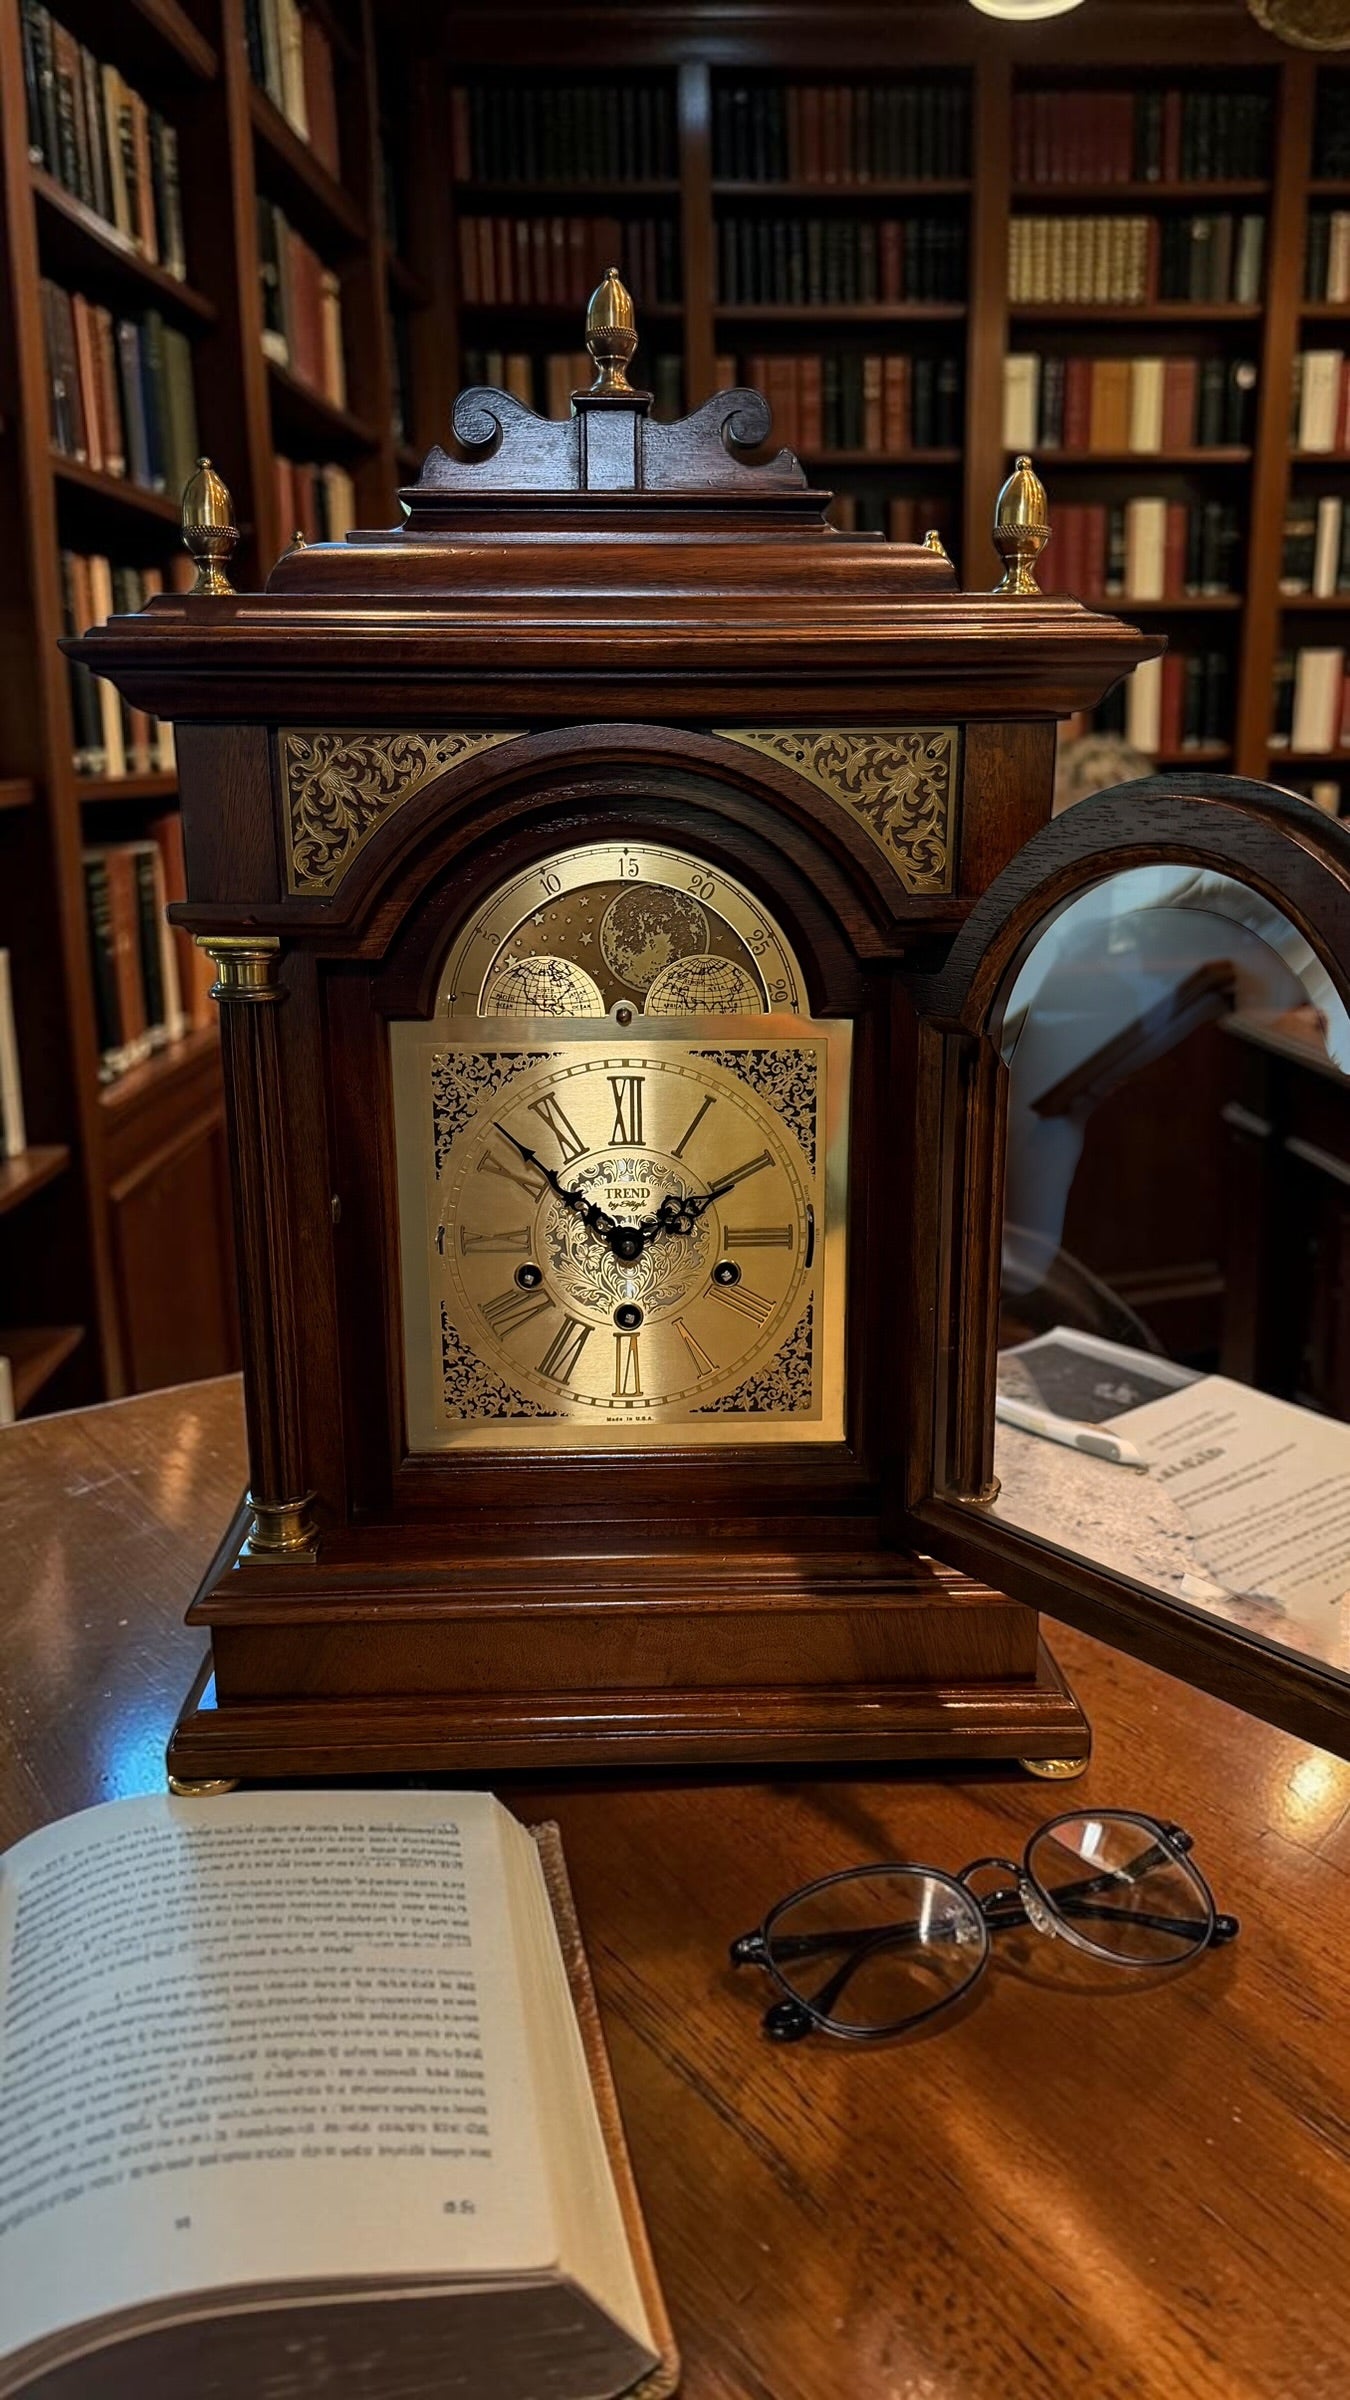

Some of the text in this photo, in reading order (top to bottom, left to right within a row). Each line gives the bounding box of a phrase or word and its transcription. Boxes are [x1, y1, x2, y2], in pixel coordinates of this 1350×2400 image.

[617, 858, 639, 877] 15
[539, 873, 562, 897] 10
[687, 874, 715, 900] 20
[482, 930, 501, 946] 5
[745, 929, 770, 956] 25
[768, 978, 788, 1003] 29
[607, 1075, 646, 1146] XII
[671, 1094, 717, 1159] I
[528, 1091, 590, 1165] XI
[477, 1150, 549, 1204] X
[707, 1149, 776, 1193] II
[604, 1187, 651, 1199] TREND
[608, 1201, 619, 1211] by
[460, 1225, 532, 1257] IX
[724, 1224, 793, 1250] III
[478, 1288, 556, 1343] VIII
[534, 1312, 595, 1386] VII
[672, 1316, 720, 1380] V
[612, 1332, 643, 1397] VI
